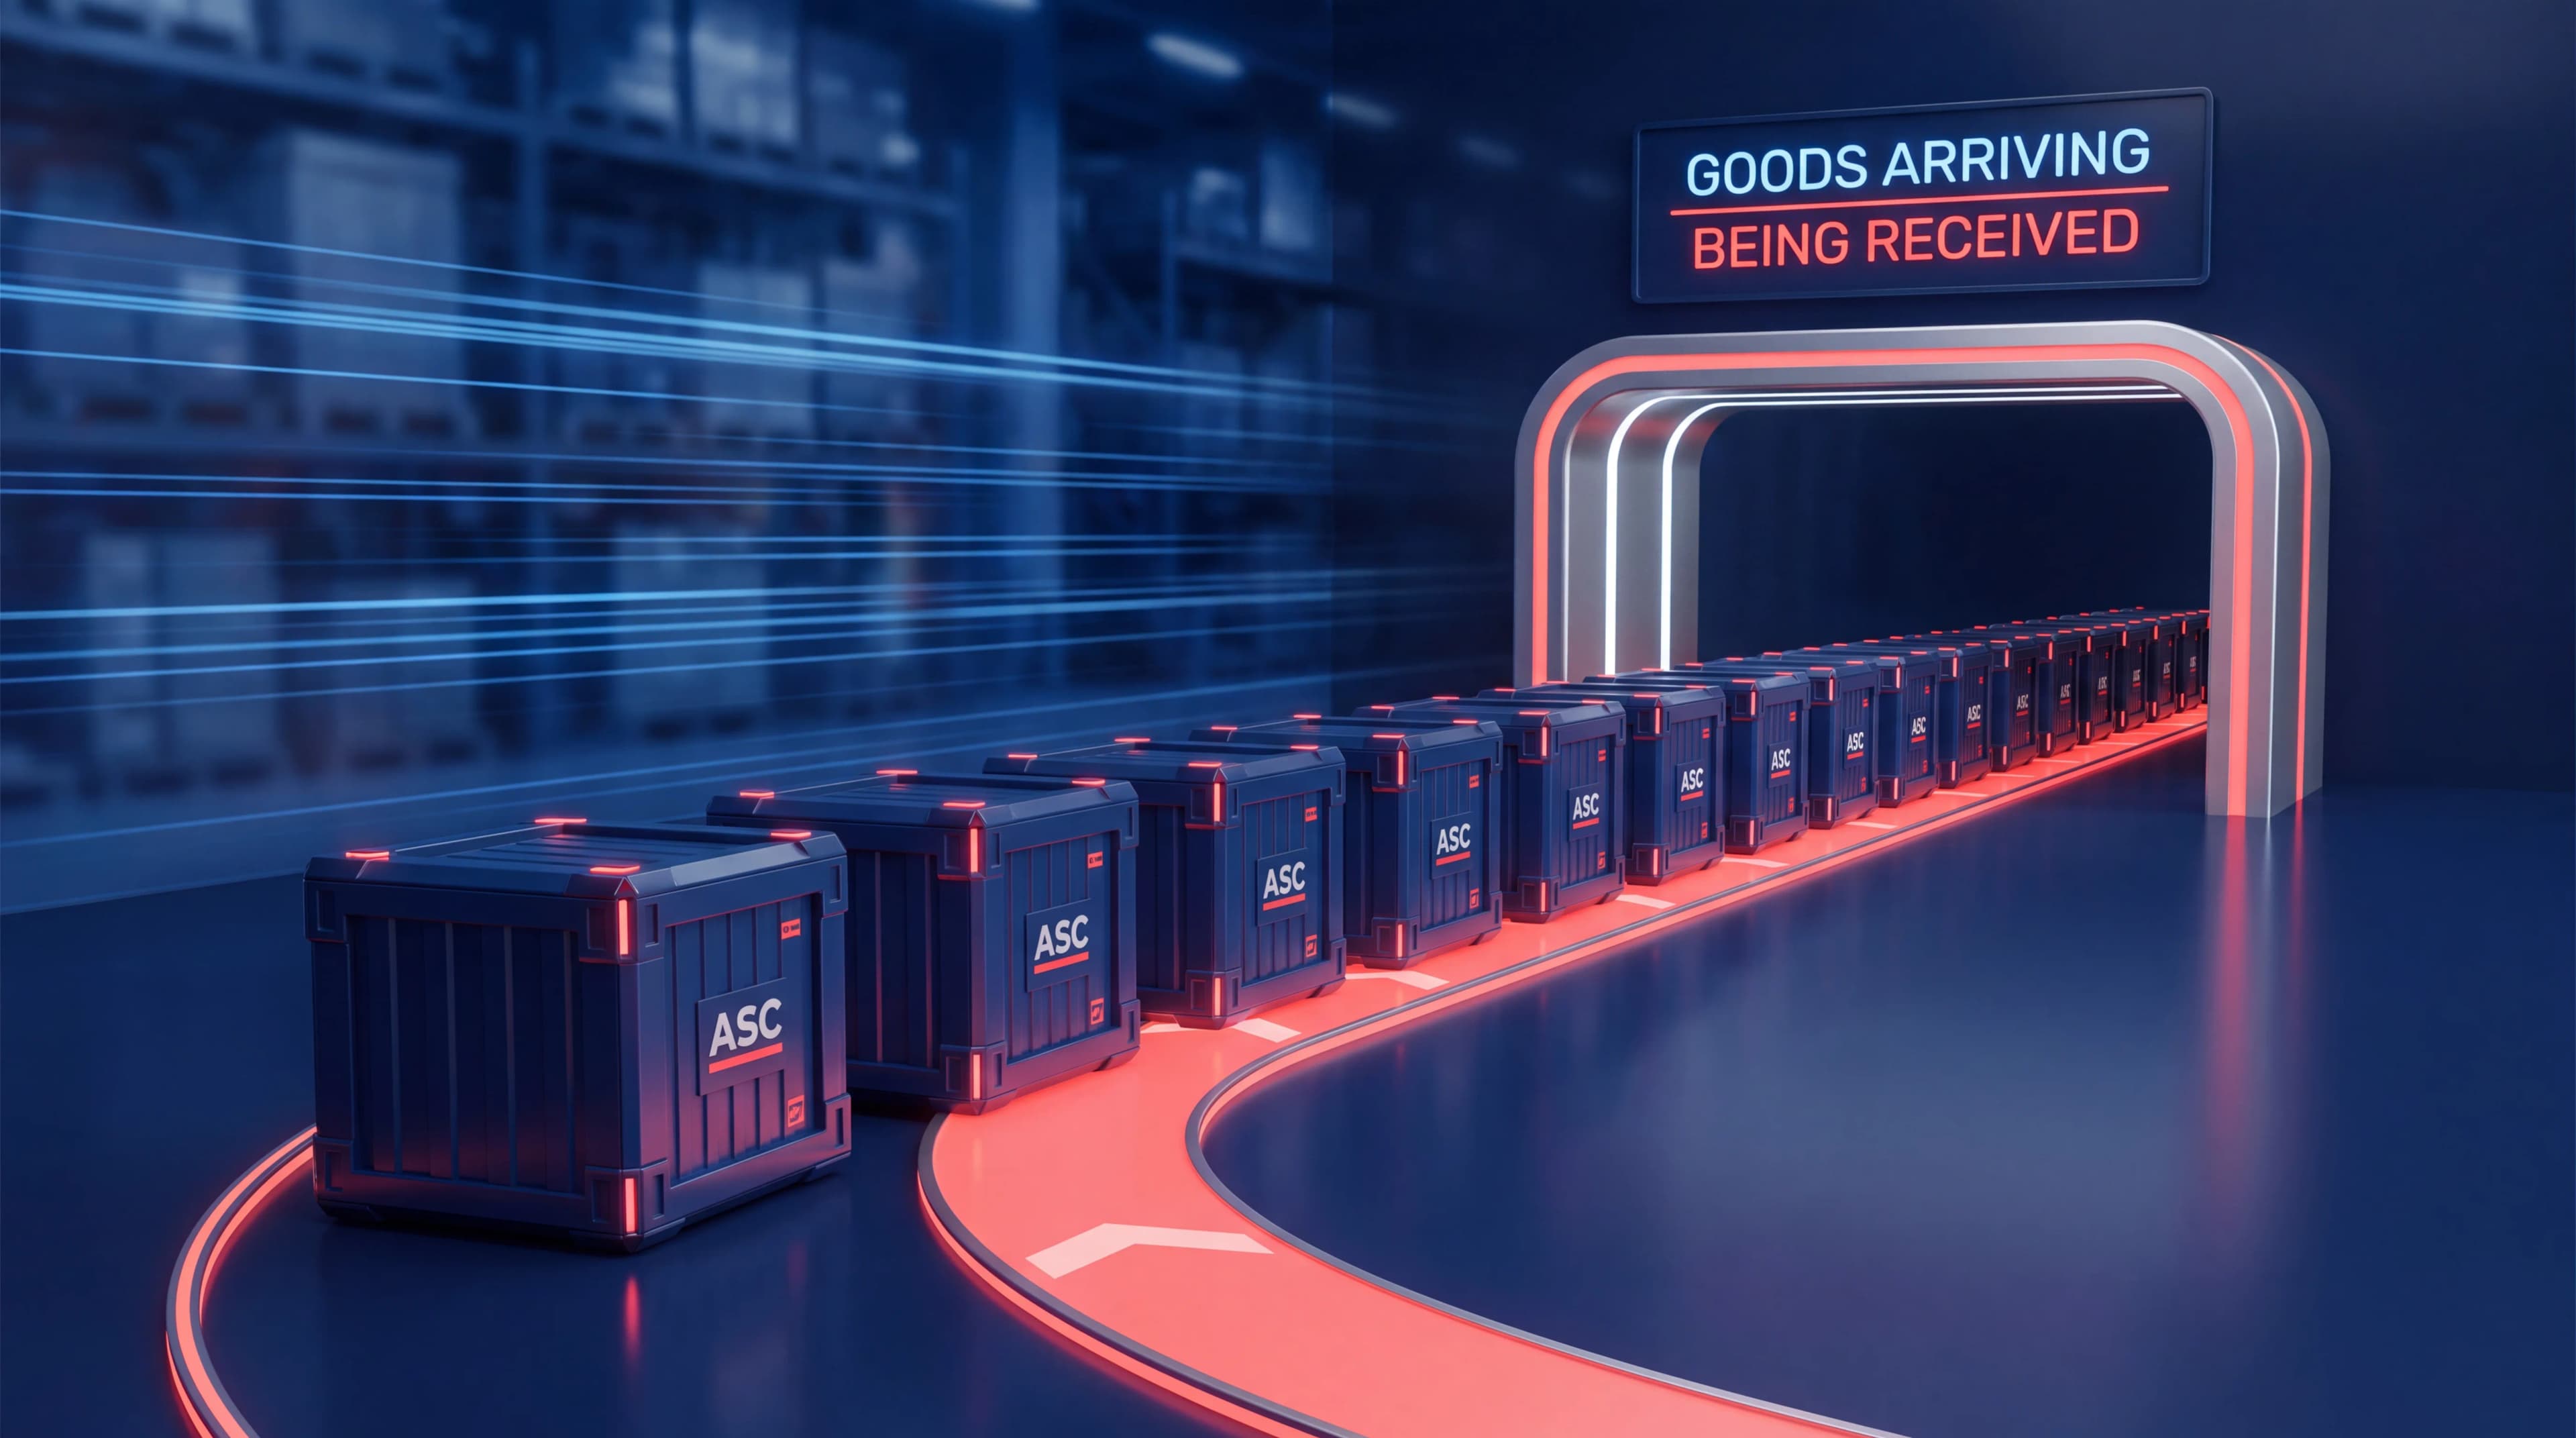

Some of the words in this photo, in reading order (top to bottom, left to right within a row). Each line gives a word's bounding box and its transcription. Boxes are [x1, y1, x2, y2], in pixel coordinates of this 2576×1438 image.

[1686, 144, 1868, 196] GOODS
[1882, 127, 2150, 187] ARRIVING
[1693, 221, 1849, 270] BEING
[1867, 208, 2139, 262] RECEIVED
[1967, 704, 1981, 722] ASC
[1847, 731, 1864, 752] ASC
[1771, 748, 1790, 771] ASC
[1680, 768, 1704, 792] ASC
[1572, 792, 1599, 821] ASC
[1436, 823, 1471, 856] ASC
[1263, 861, 1305, 899] ASC
[1034, 915, 1089, 961] ASC
[708, 998, 783, 1058] ASC
